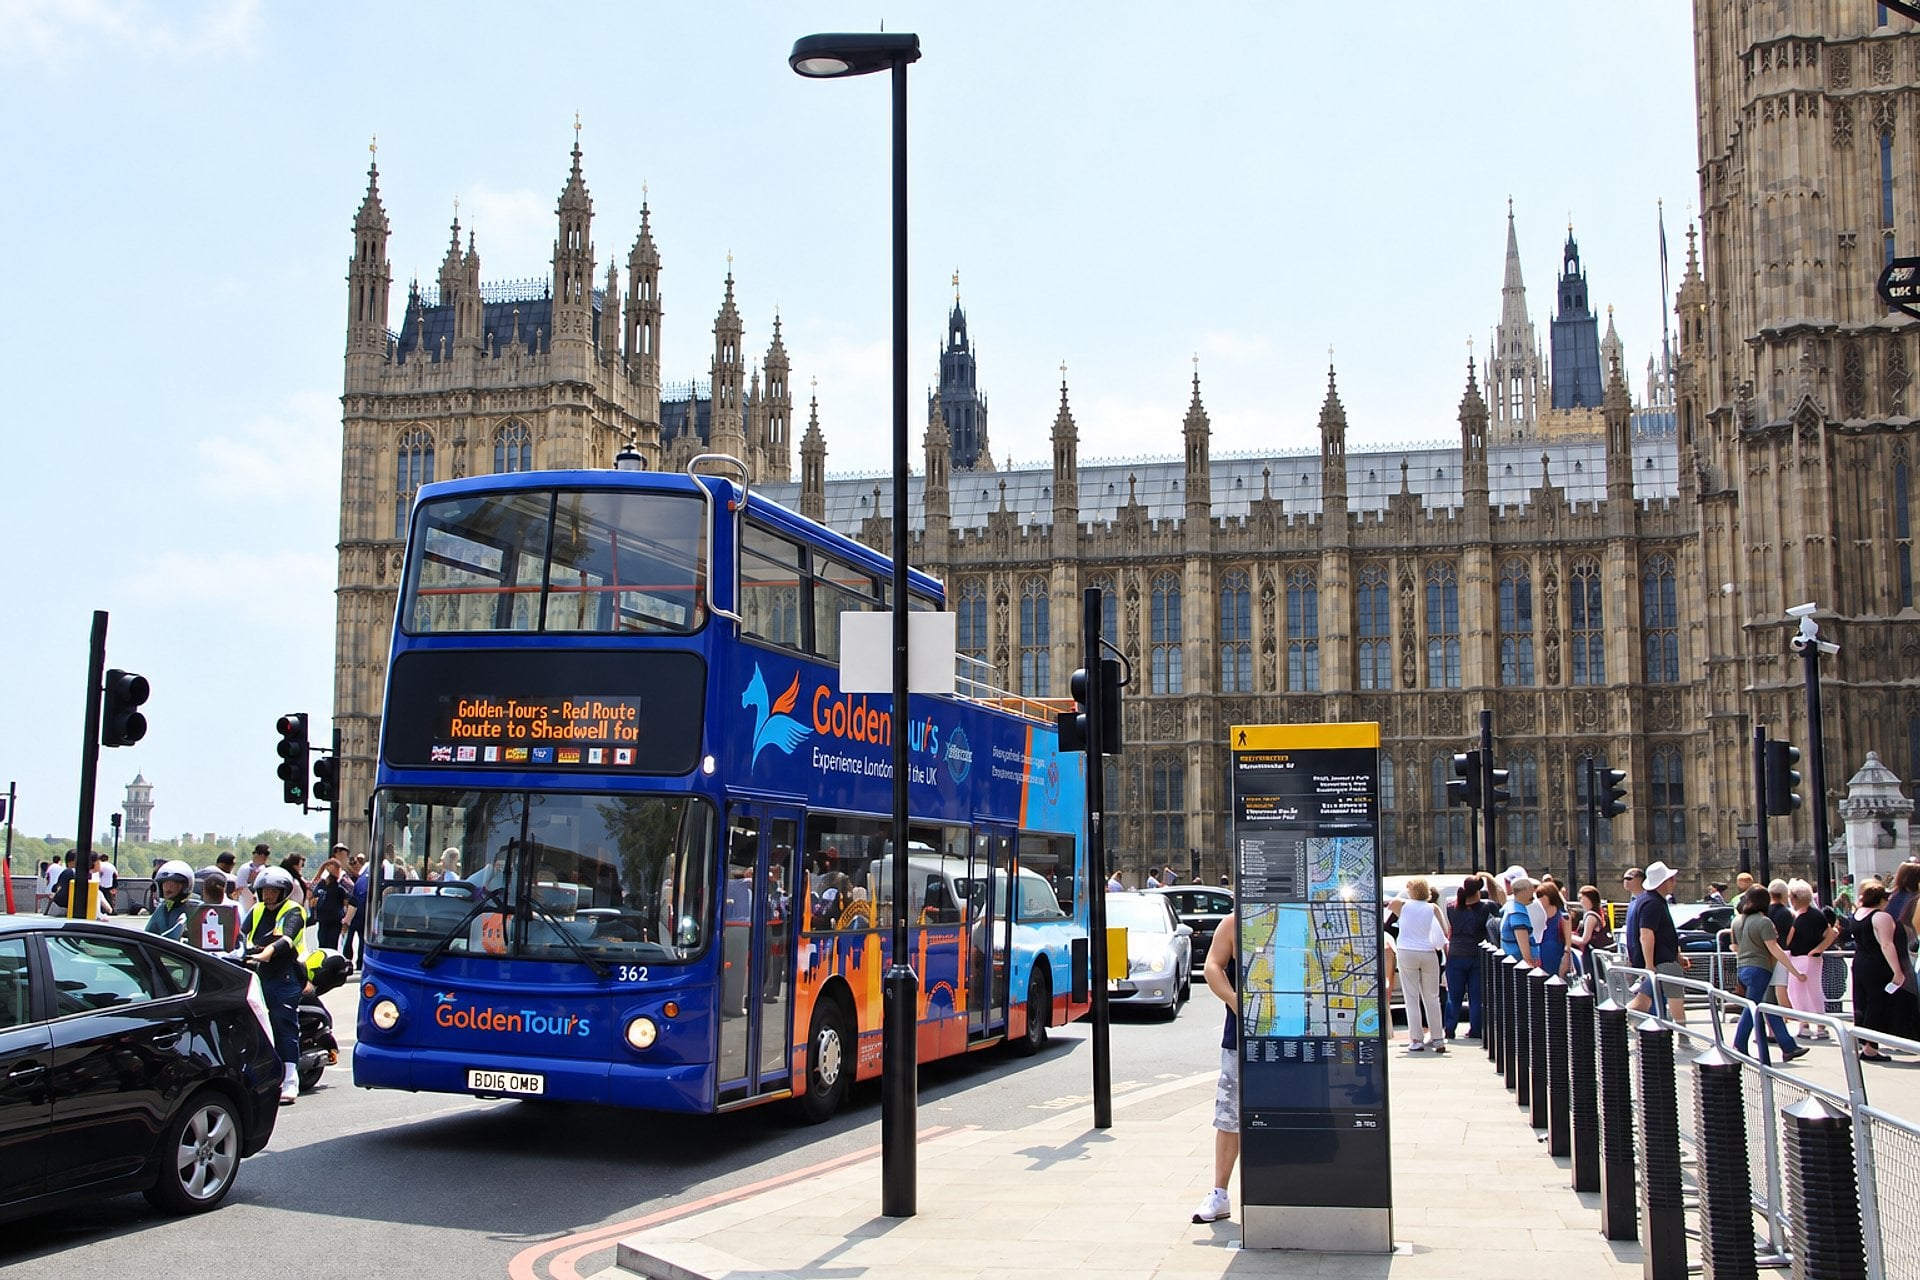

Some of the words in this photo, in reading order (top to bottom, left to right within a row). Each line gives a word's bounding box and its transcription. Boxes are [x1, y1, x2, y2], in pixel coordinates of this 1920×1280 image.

[562, 701, 590, 719] Red
[592, 702, 636, 720] Route
[451, 718, 501, 738] Route
[507, 720, 526, 738] to
[531, 720, 608, 739] Shadwell
[614, 720, 639, 740] for
[813, 746, 863, 775] Experience
[864, 756, 893, 779] London
[912, 765, 925, 784] the
[926, 766, 938, 786] UK
[618, 965, 649, 982] 362
[435, 1004, 590, 1037] GoldenTours
[474, 1072, 505, 1090] BD16
[510, 1075, 539, 1091] OMB
